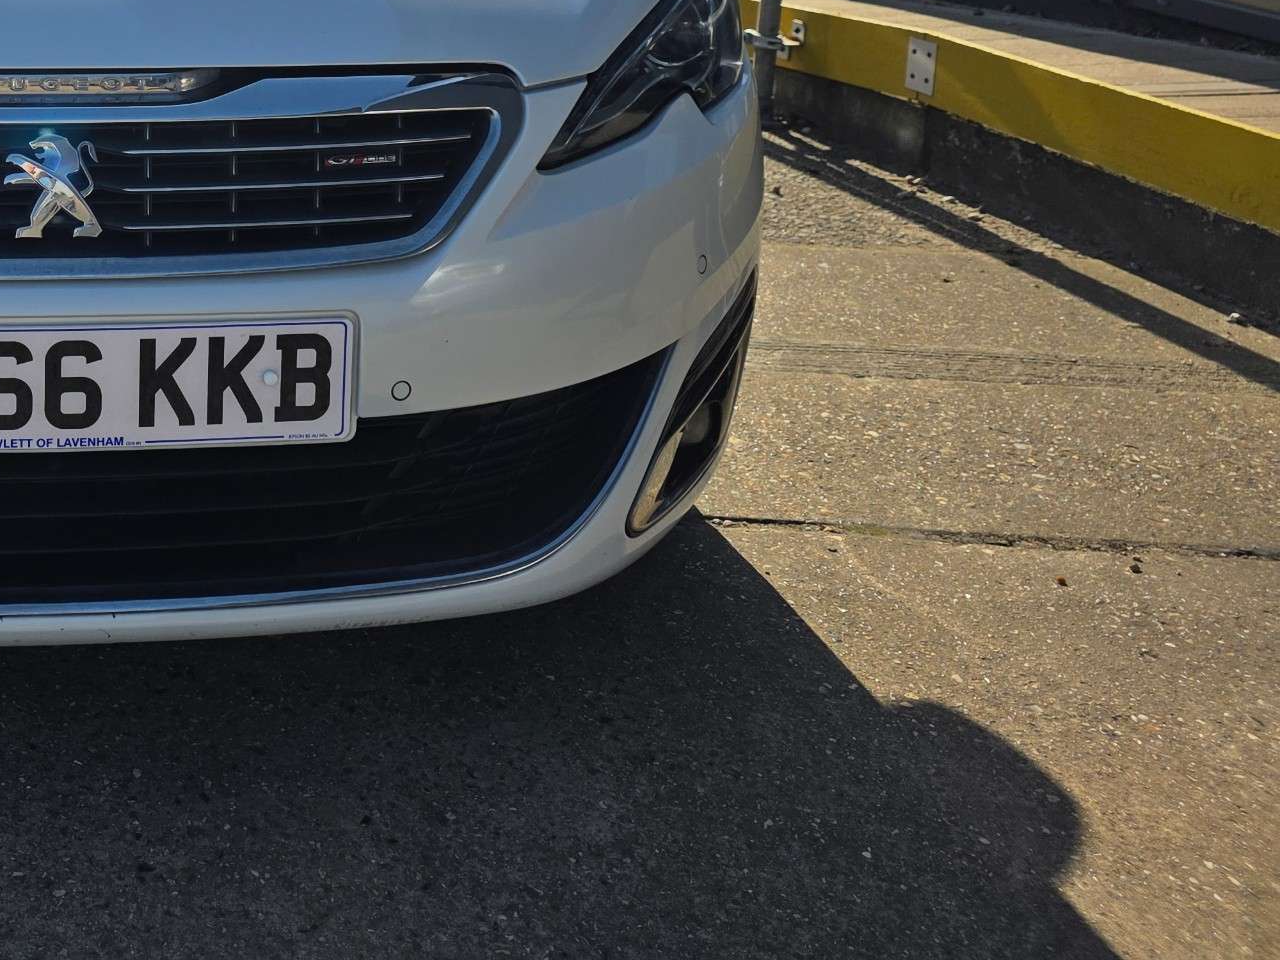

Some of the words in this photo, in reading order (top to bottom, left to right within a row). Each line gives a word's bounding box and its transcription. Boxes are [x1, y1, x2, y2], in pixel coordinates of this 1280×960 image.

[139, 332, 333, 428] KKB
[36, 438, 53, 448] OF
[56, 436, 125, 448] LAVENHAM
